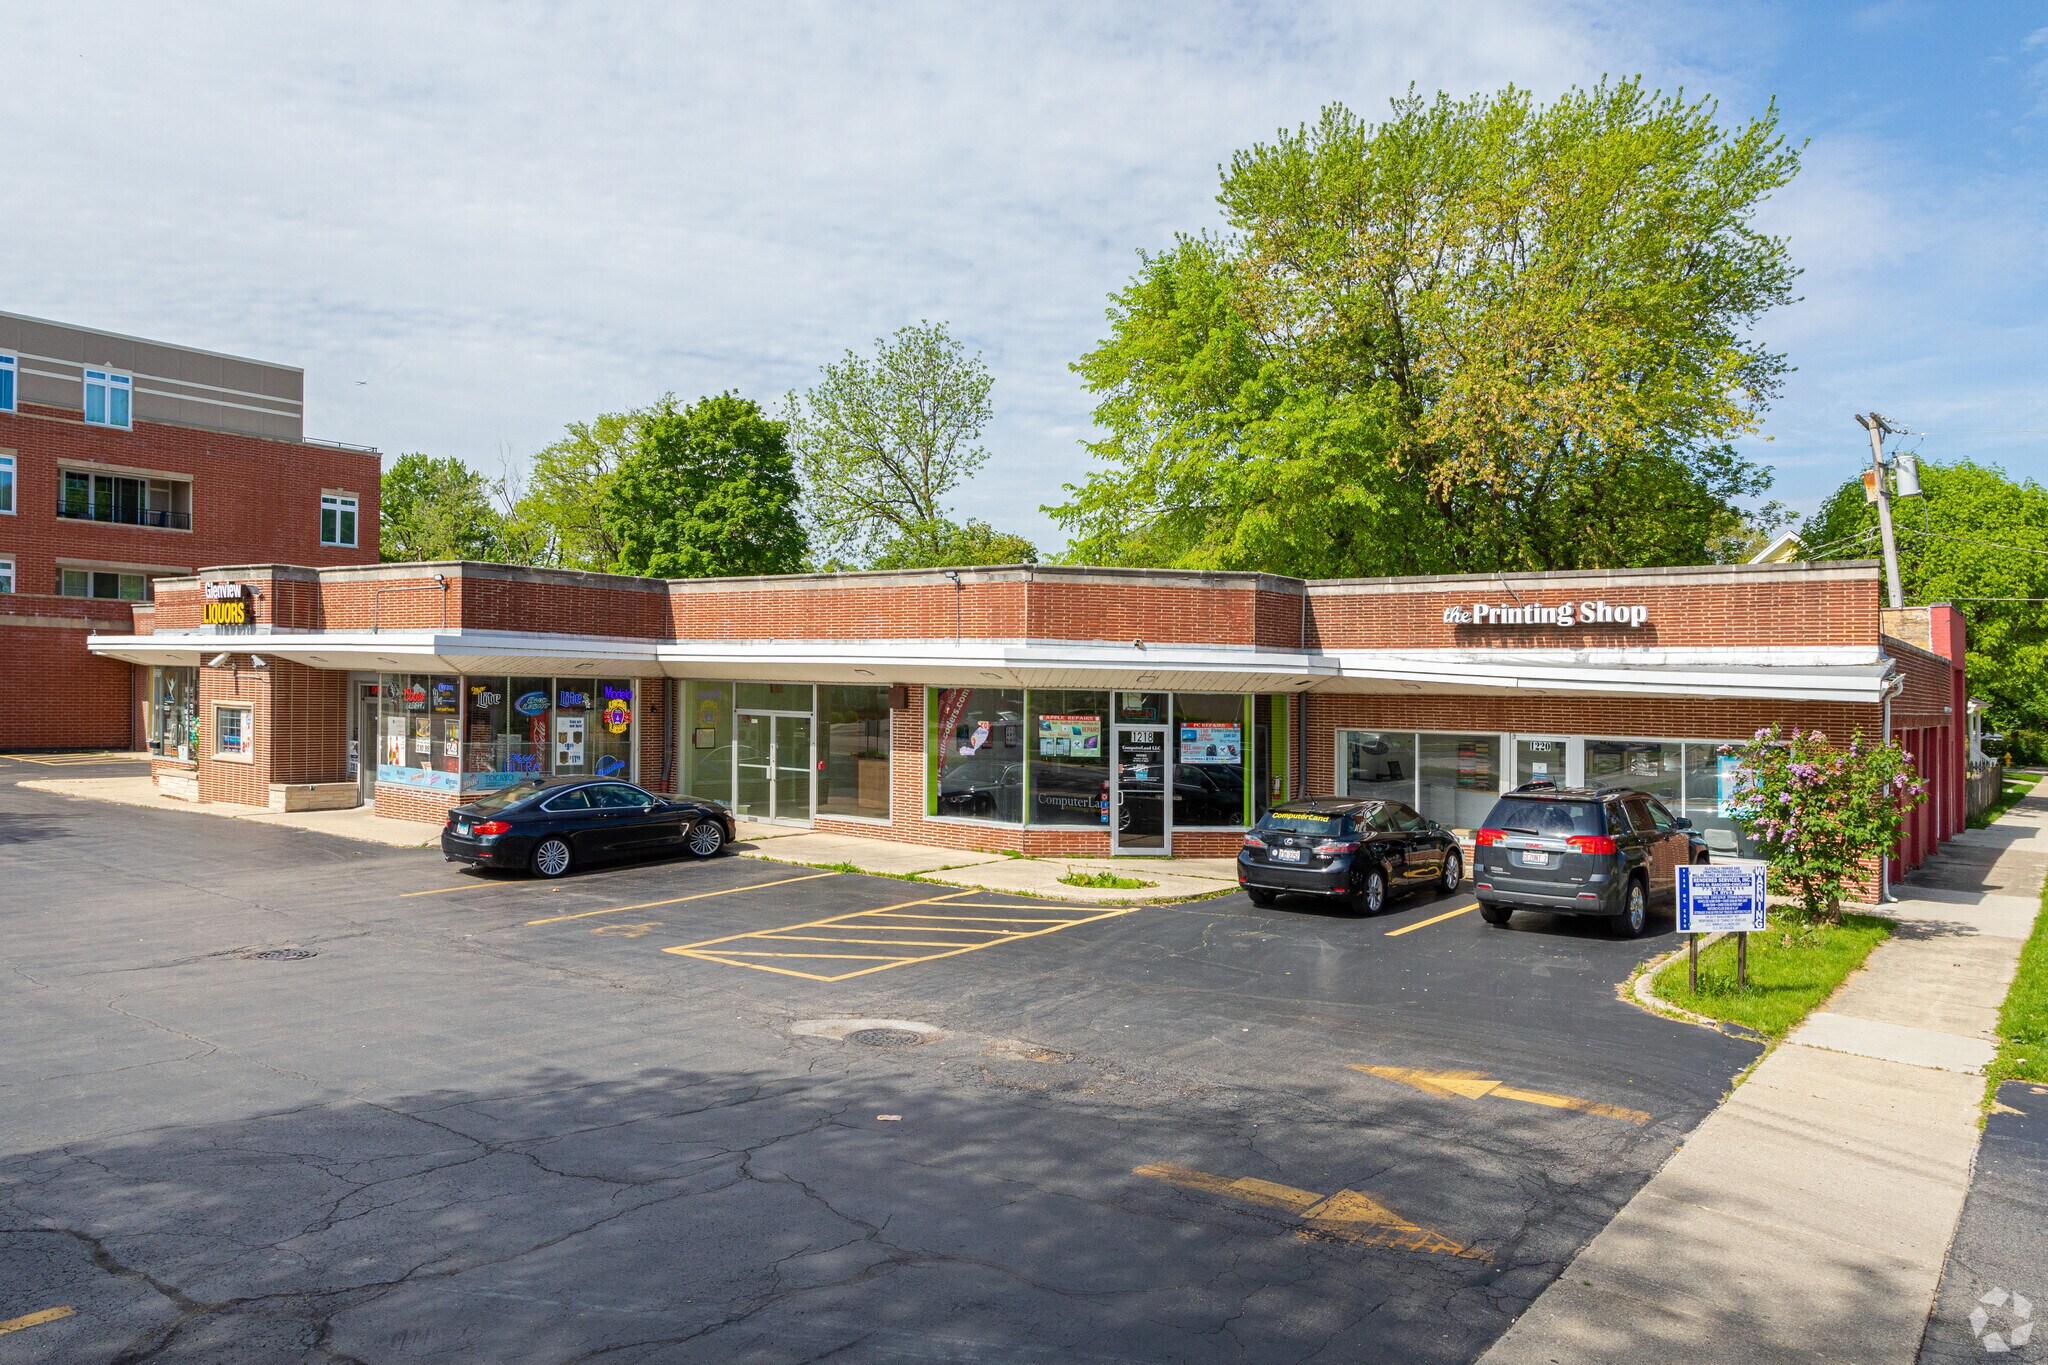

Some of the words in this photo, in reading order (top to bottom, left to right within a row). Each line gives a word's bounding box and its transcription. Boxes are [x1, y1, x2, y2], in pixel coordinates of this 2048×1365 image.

[205, 581, 241, 598] Glenview
[203, 603, 245, 624] LIQUORS
[1443, 606, 1472, 623] the
[1473, 603, 1575, 626] Printing
[1580, 601, 1649, 627] Shop
[476, 692, 501, 709] Lite
[560, 691, 582, 708] Lite
[604, 685, 633, 701] Modelo
[1132, 732, 1153, 742] 1218
[1531, 741, 1550, 751] 1220
[503, 761, 540, 773] ULTRA
[484, 773, 514, 782] TOCAYO
[1272, 812, 1330, 823] ComputerLand
[1755, 866, 1765, 929] WARNING
